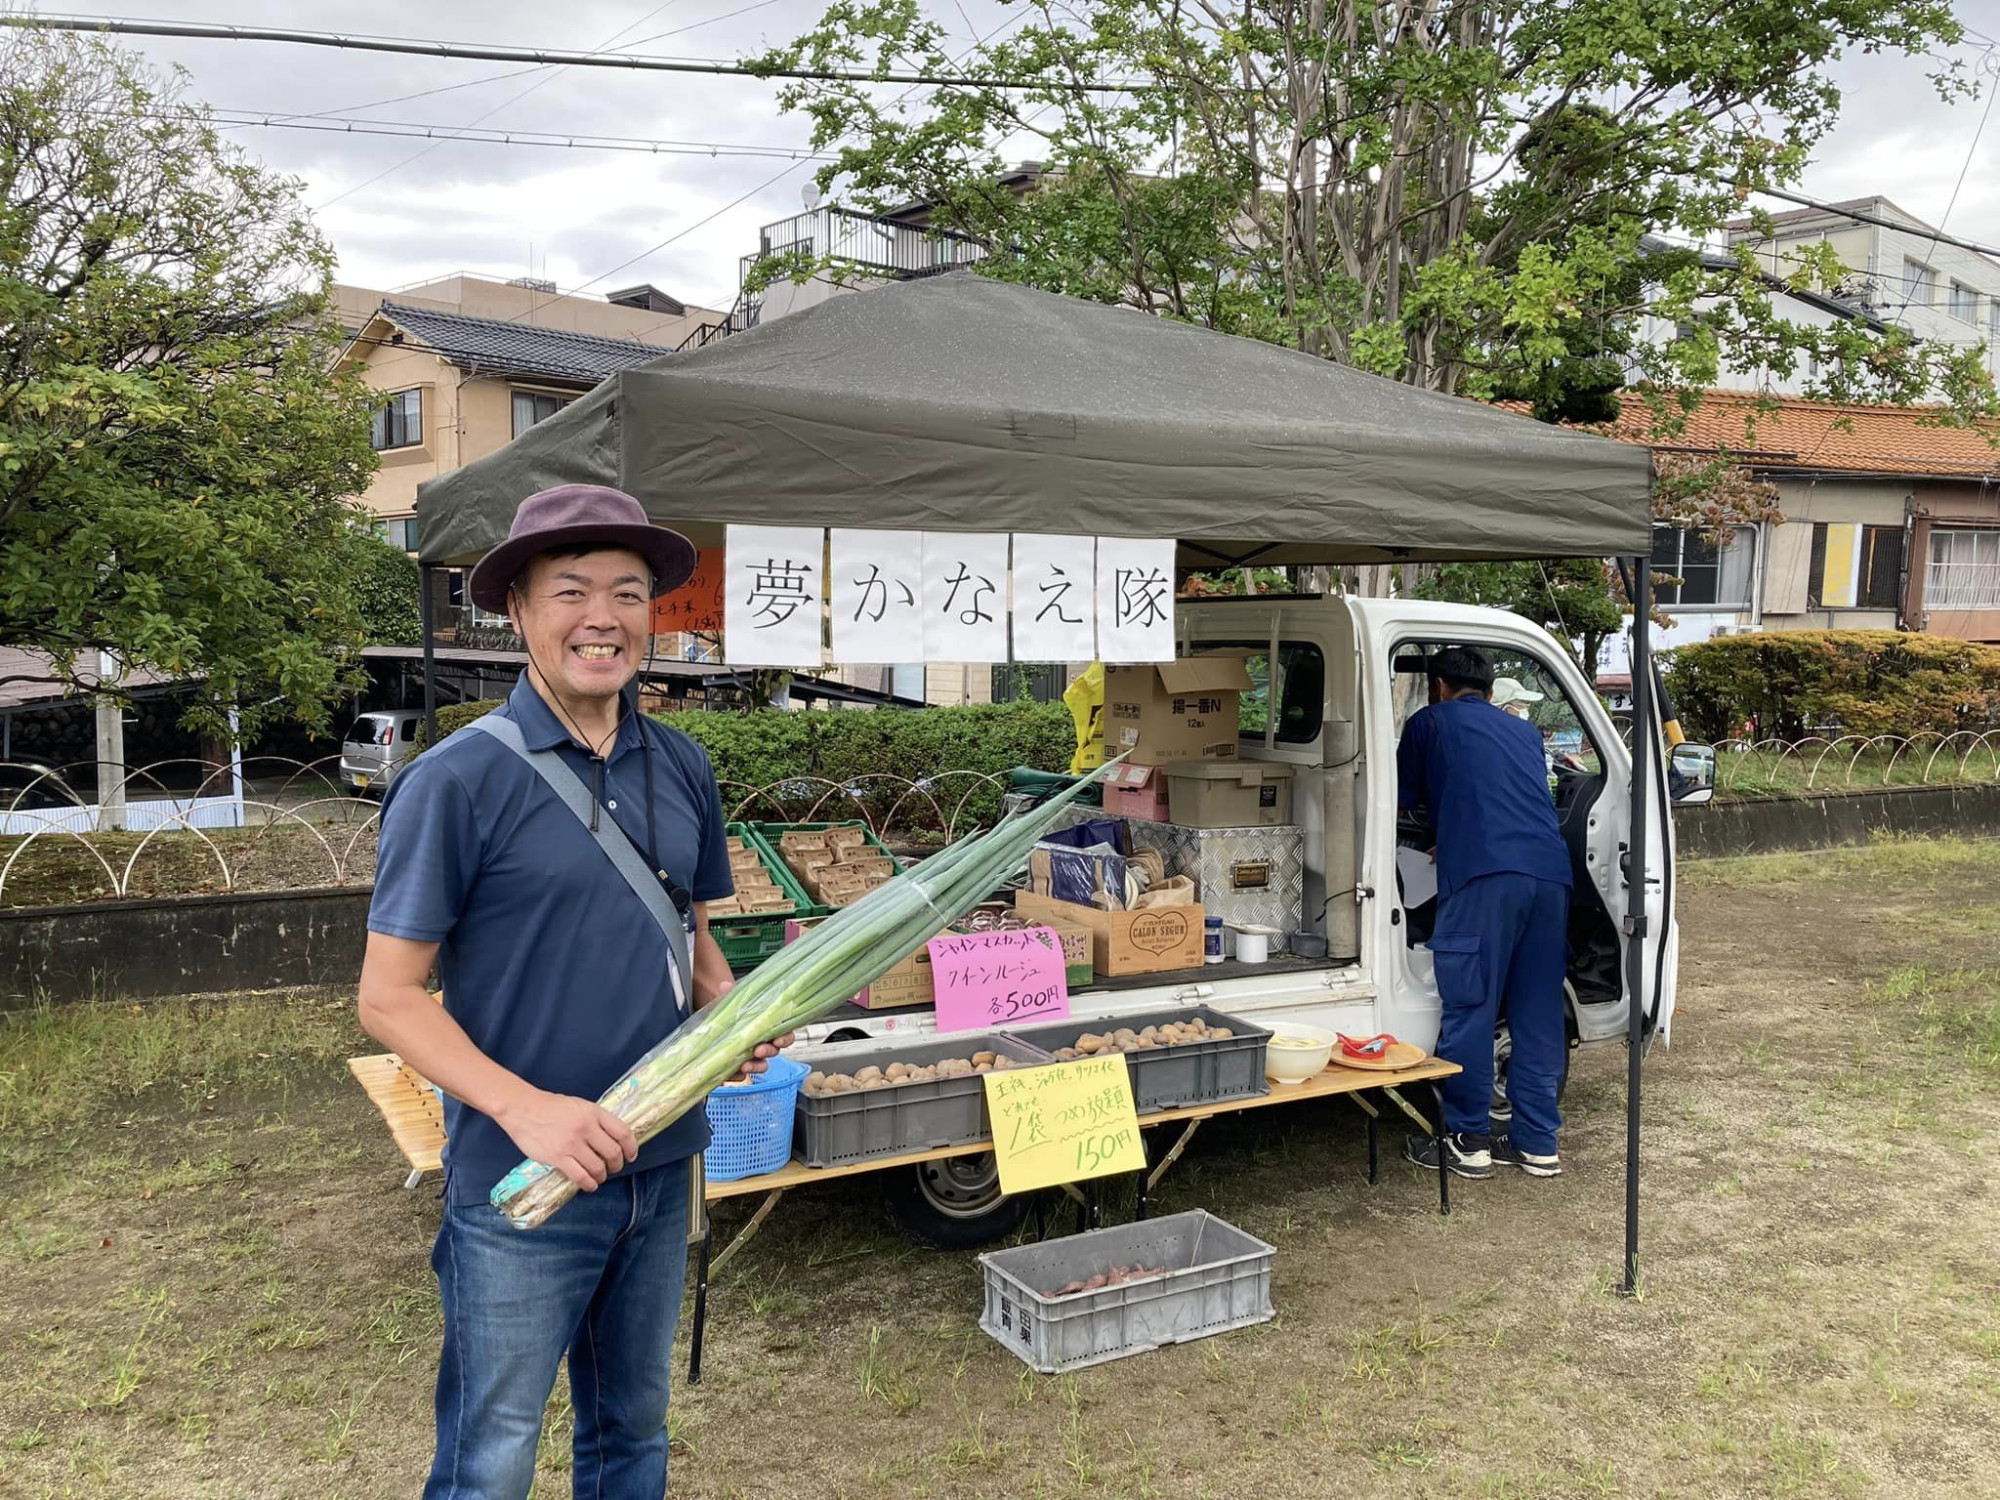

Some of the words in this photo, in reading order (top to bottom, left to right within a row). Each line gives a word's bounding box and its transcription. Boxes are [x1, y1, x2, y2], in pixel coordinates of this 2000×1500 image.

[745, 558, 1170, 629] 夢かなえ隊
[1076, 1128, 1132, 1171] 150円
